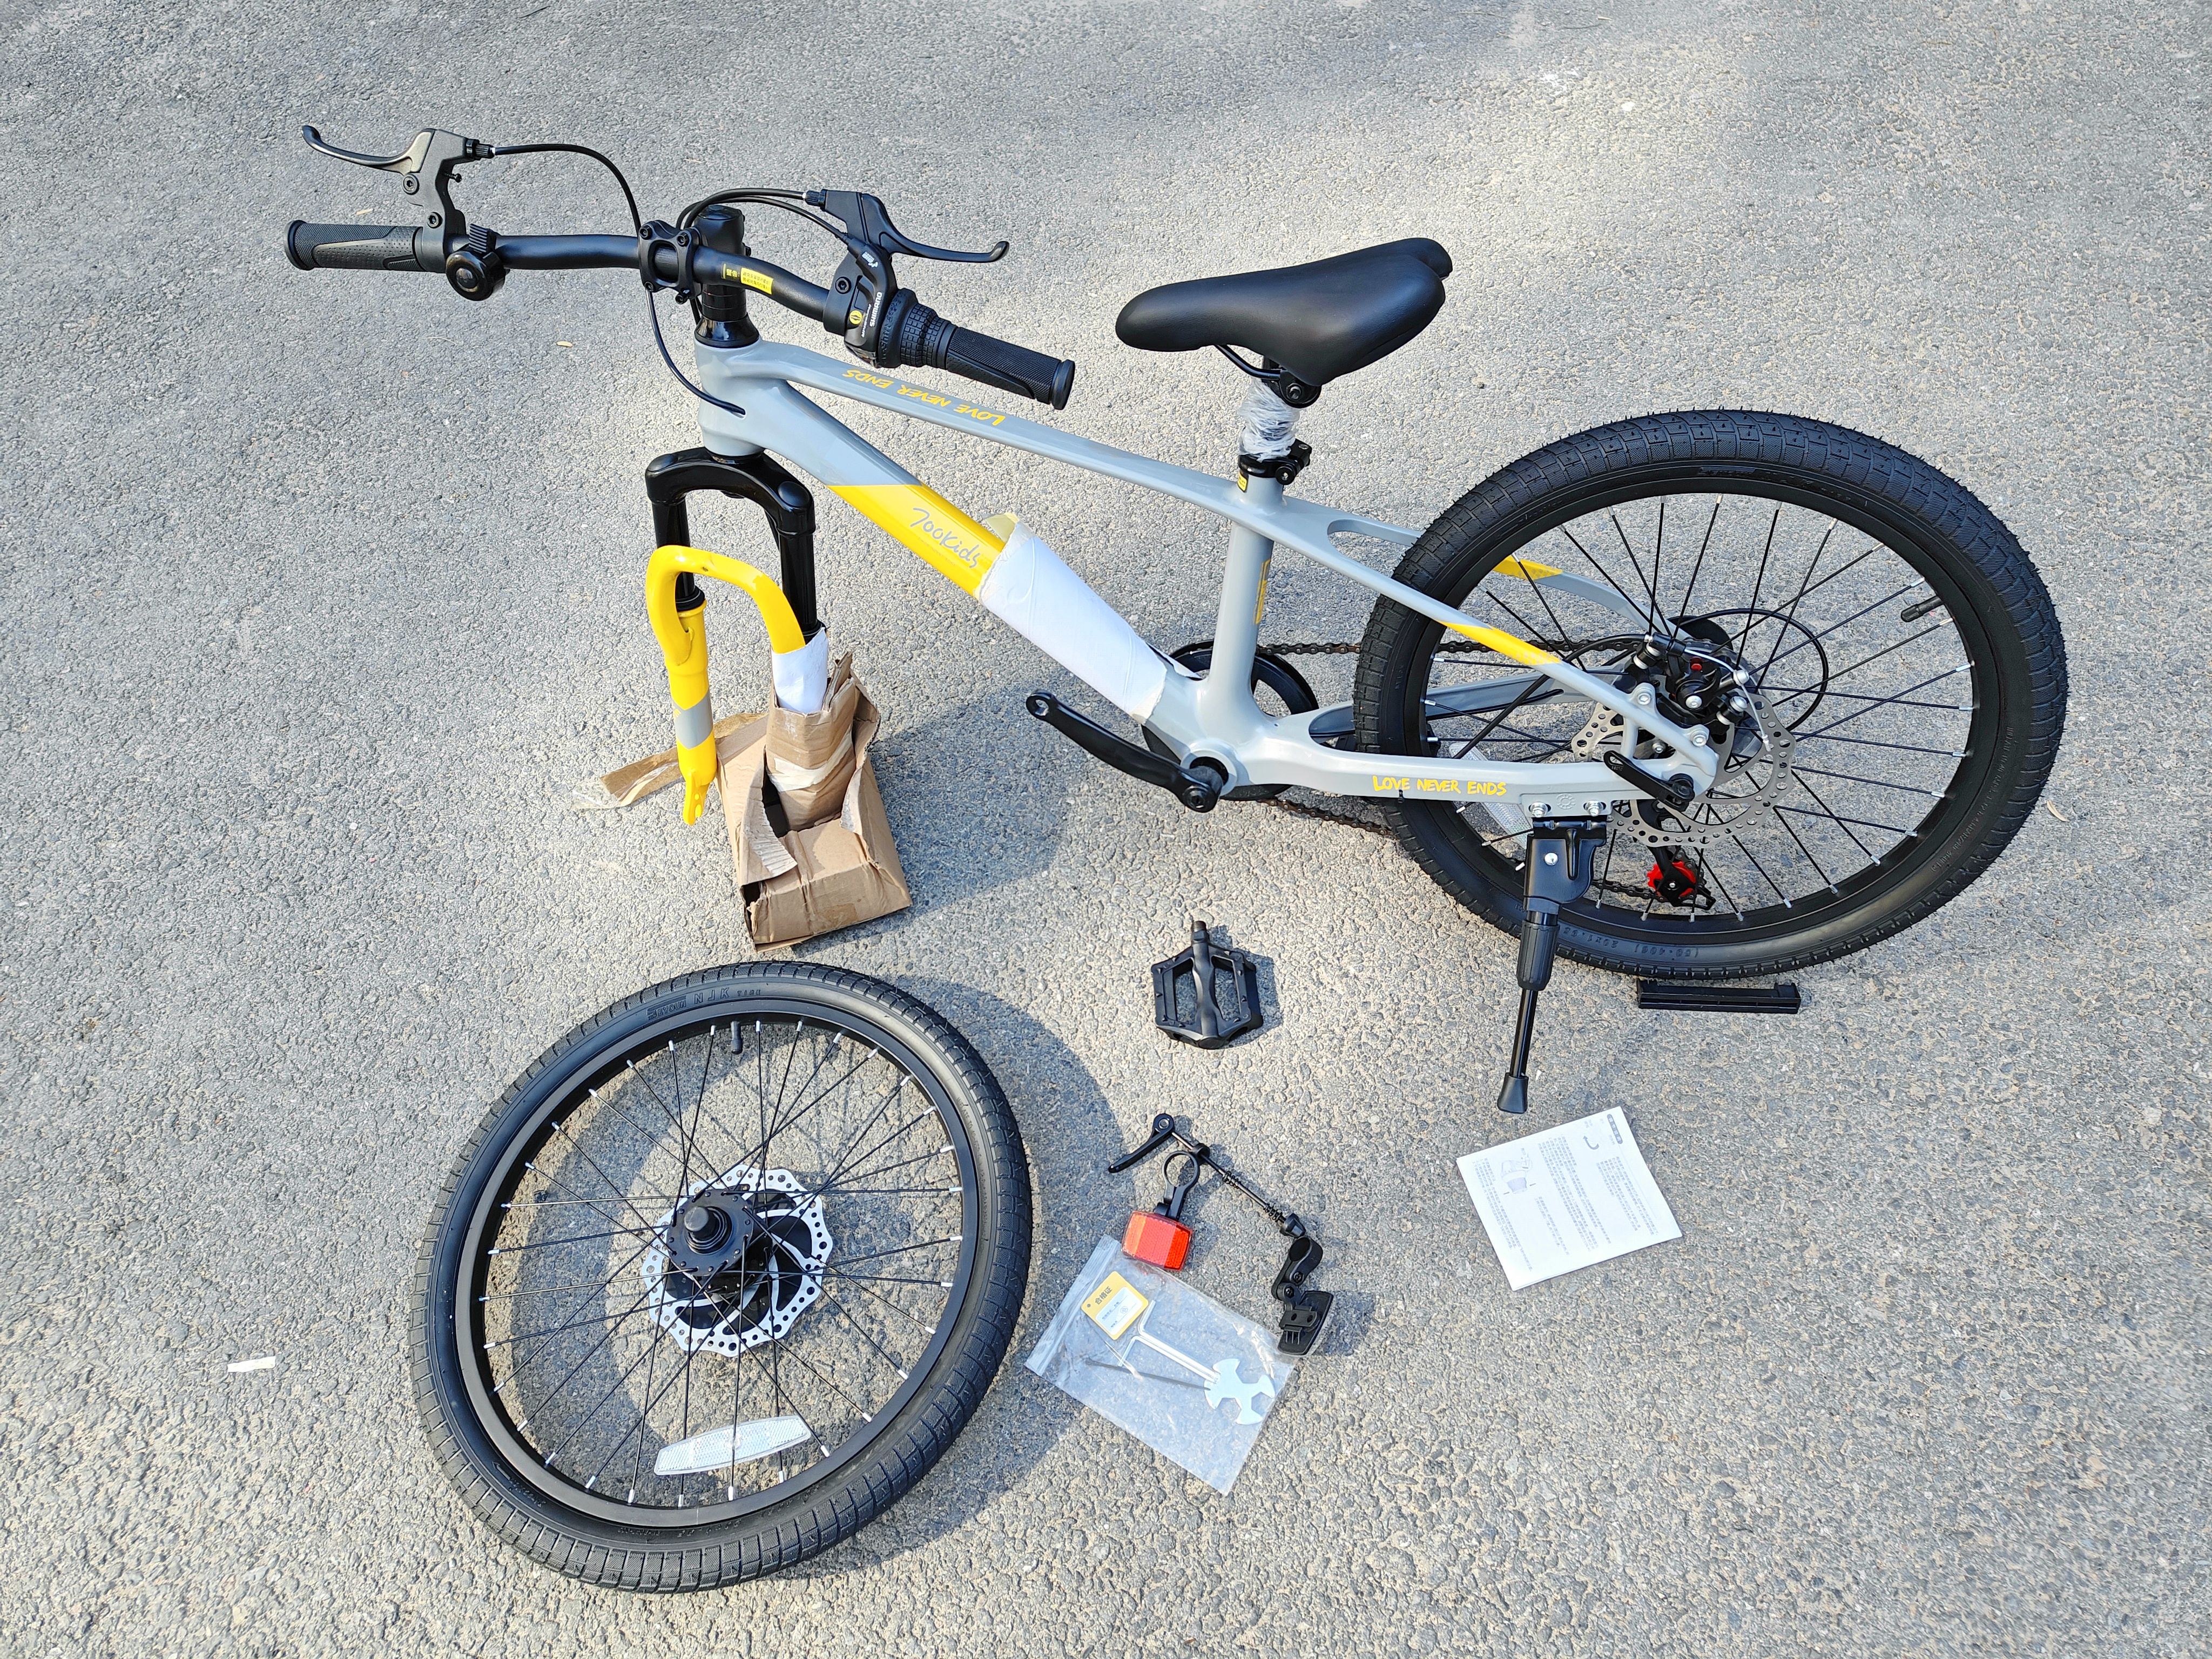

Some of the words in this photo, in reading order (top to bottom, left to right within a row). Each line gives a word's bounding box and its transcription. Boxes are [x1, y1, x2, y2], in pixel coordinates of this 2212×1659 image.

[869, 292, 882, 327] SHIMANO
[842, 369, 894, 388] ENDS
[897, 385, 952, 407] NEVER
[953, 404, 1006, 426] LOVE
[1372, 775, 1410, 791] LOVE
[1417, 778, 1461, 794] NEVER
[1467, 781, 1507, 796] ENDS
[1095, 1286, 1112, 1305] 合格证
